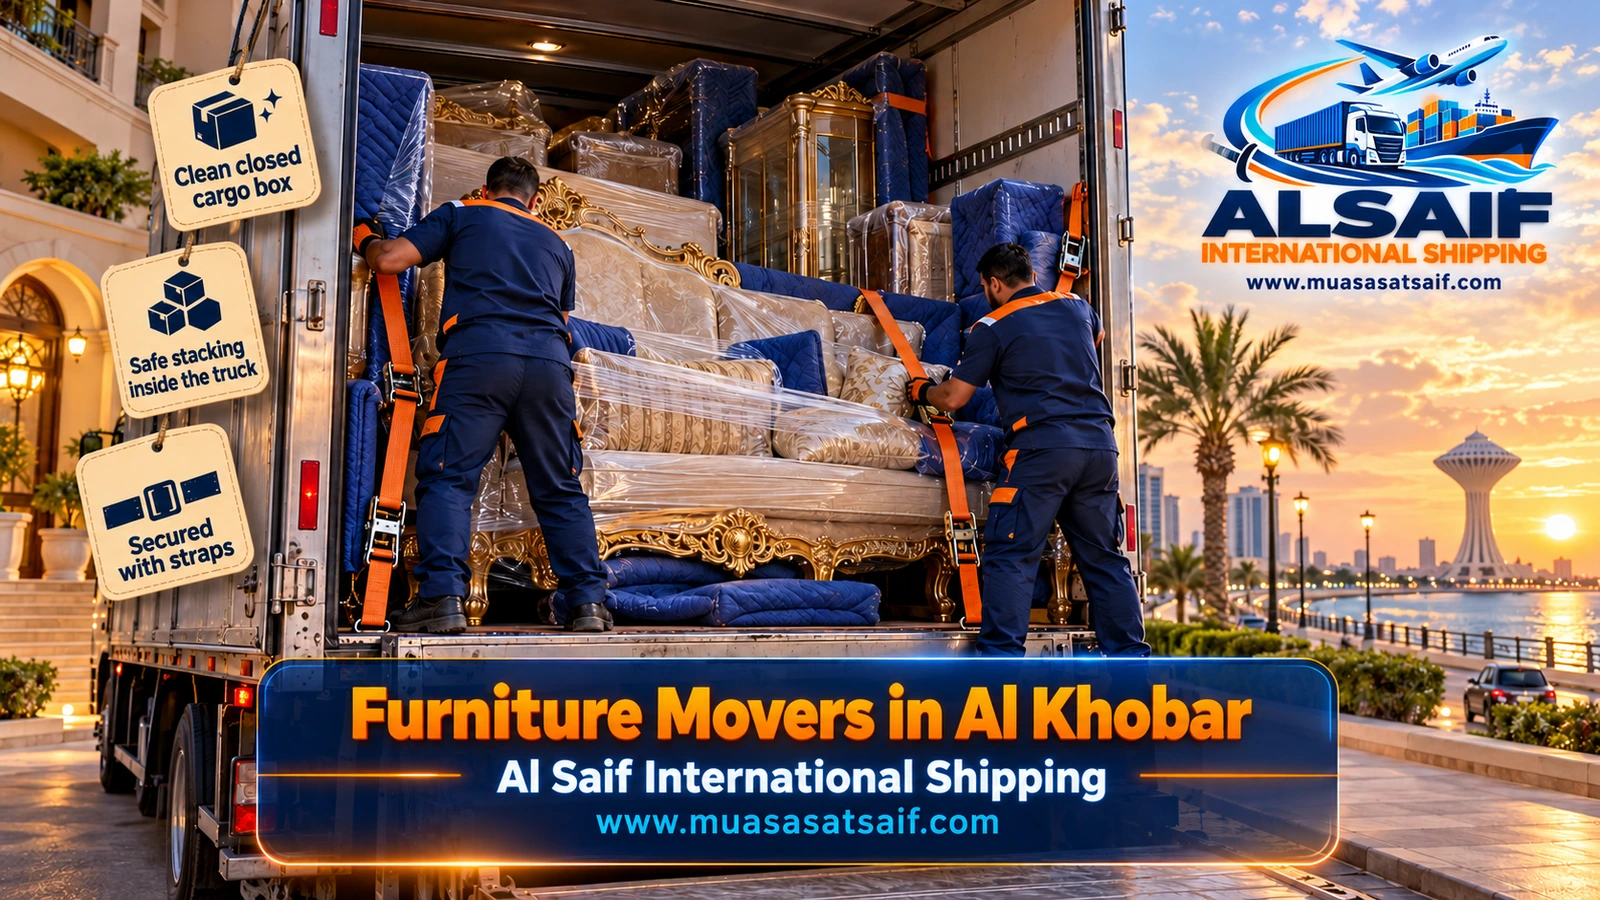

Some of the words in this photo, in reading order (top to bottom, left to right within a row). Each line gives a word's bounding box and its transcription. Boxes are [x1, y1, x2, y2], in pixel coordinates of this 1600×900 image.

[174, 163, 232, 187] Clean
[235, 145, 302, 173] closed
[193, 183, 250, 208] cargo
[253, 176, 293, 197] box
[130, 352, 168, 374] Safe
[171, 340, 245, 367] stacking
[128, 376, 178, 398] inside
[181, 370, 210, 389] the
[212, 359, 258, 383] truck
[128, 517, 214, 555] Secured
[118, 555, 165, 581] with
[169, 541, 235, 570] straps
